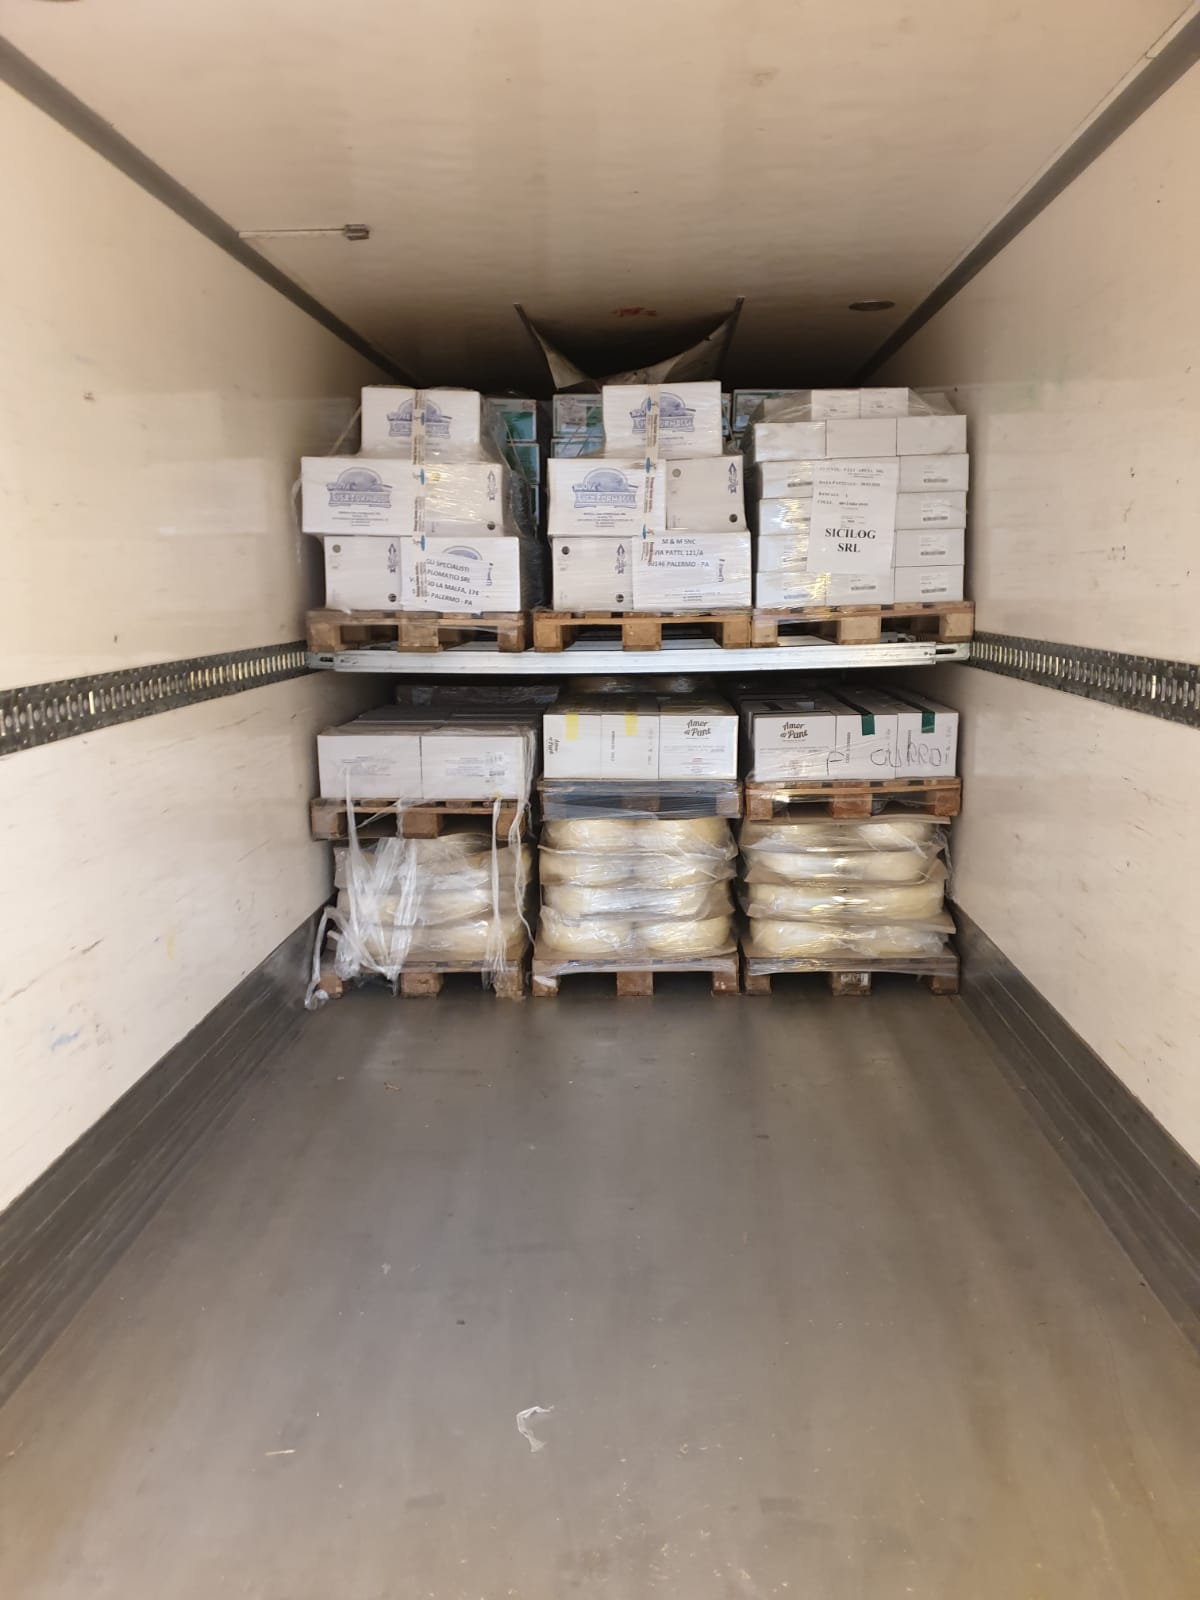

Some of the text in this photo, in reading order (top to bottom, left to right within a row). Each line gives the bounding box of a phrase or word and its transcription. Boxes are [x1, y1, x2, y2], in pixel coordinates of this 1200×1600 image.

[825, 527, 877, 540] SICILOG
[837, 542, 862, 553] SRL
[436, 560, 470, 573] SPECIALISTI
[431, 592, 460, 604] PALERMO
[782, 721, 805, 731] Amor
